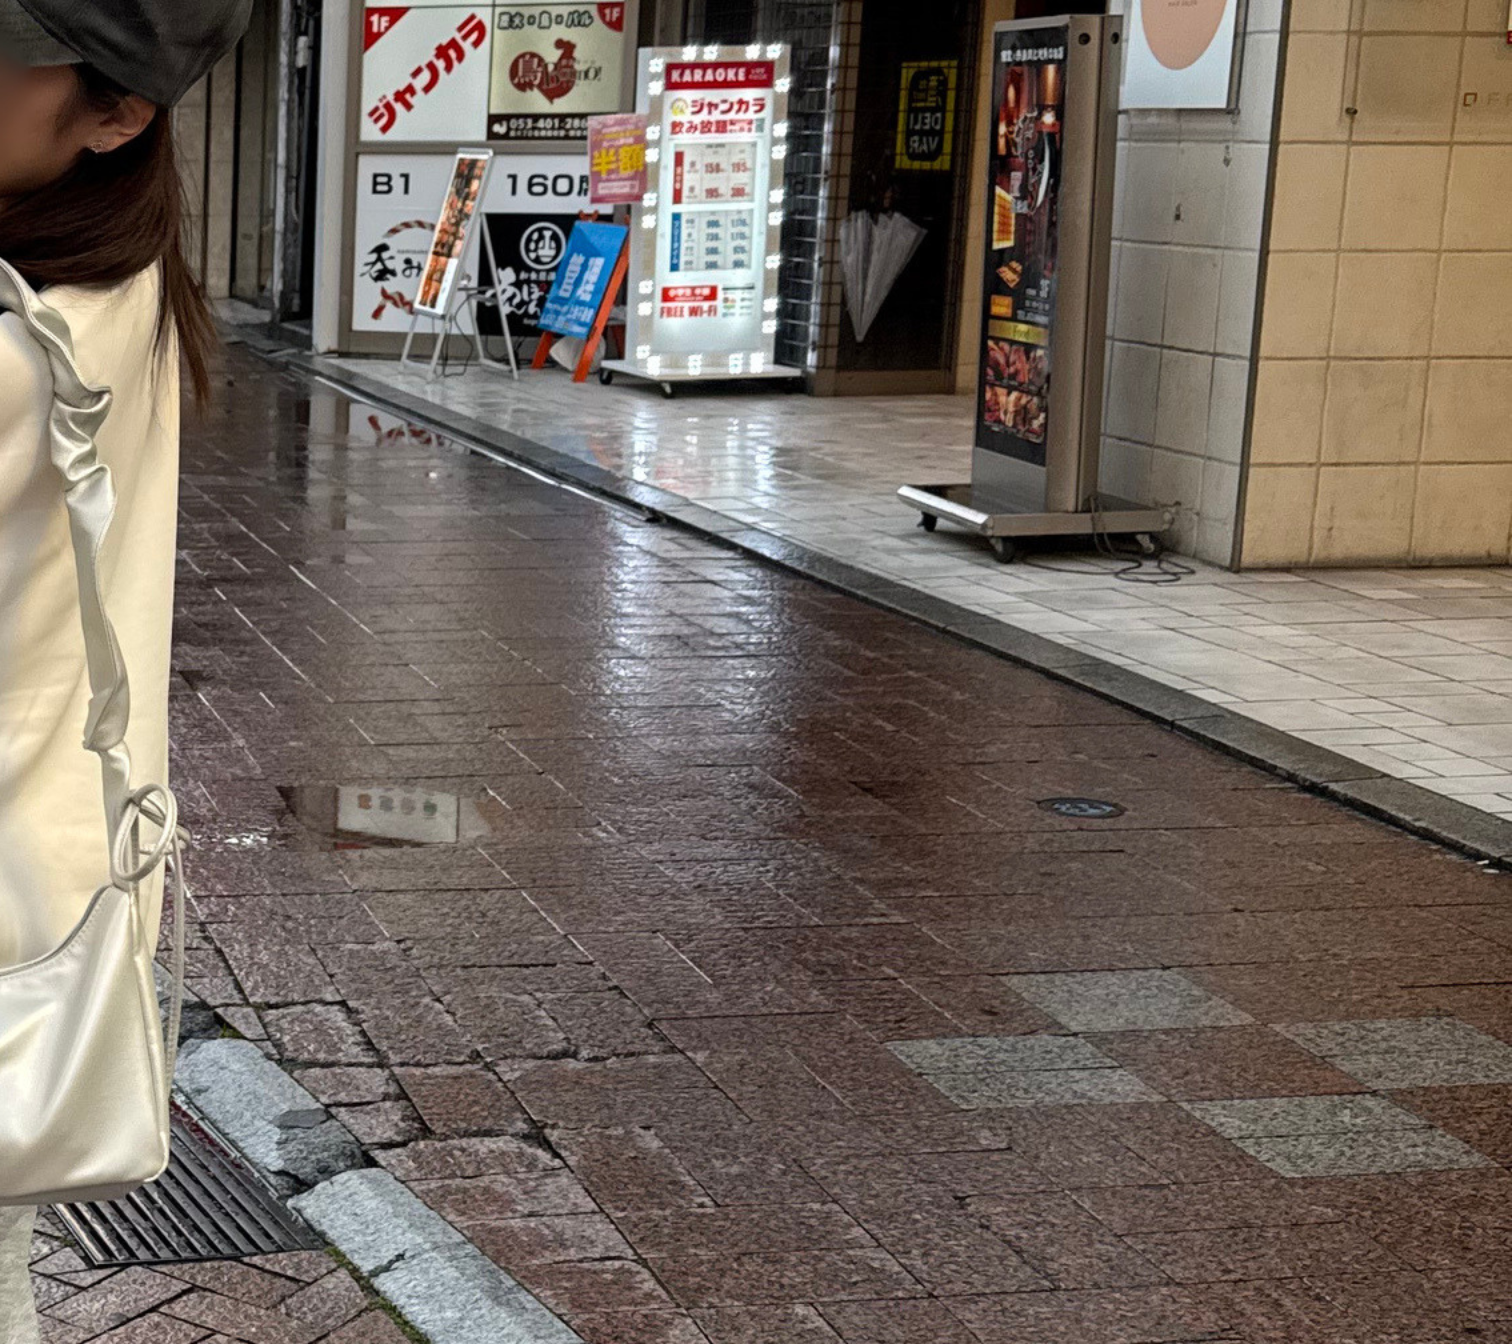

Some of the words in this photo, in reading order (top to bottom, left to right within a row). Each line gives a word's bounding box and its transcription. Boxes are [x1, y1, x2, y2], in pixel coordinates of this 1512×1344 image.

[369, 13, 390, 33] 1F
[604, 7, 621, 22] 1F
[368, 12, 487, 135] ジャンカラ
[671, 67, 746, 83] KARAOKE
[691, 97, 766, 115] ジャンカラ
[509, 117, 588, 129] 053-401-286
[670, 119, 728, 135] 飲み放題
[592, 144, 645, 176] 半額
[371, 173, 410, 195] B1
[660, 306, 684, 318] FREE
